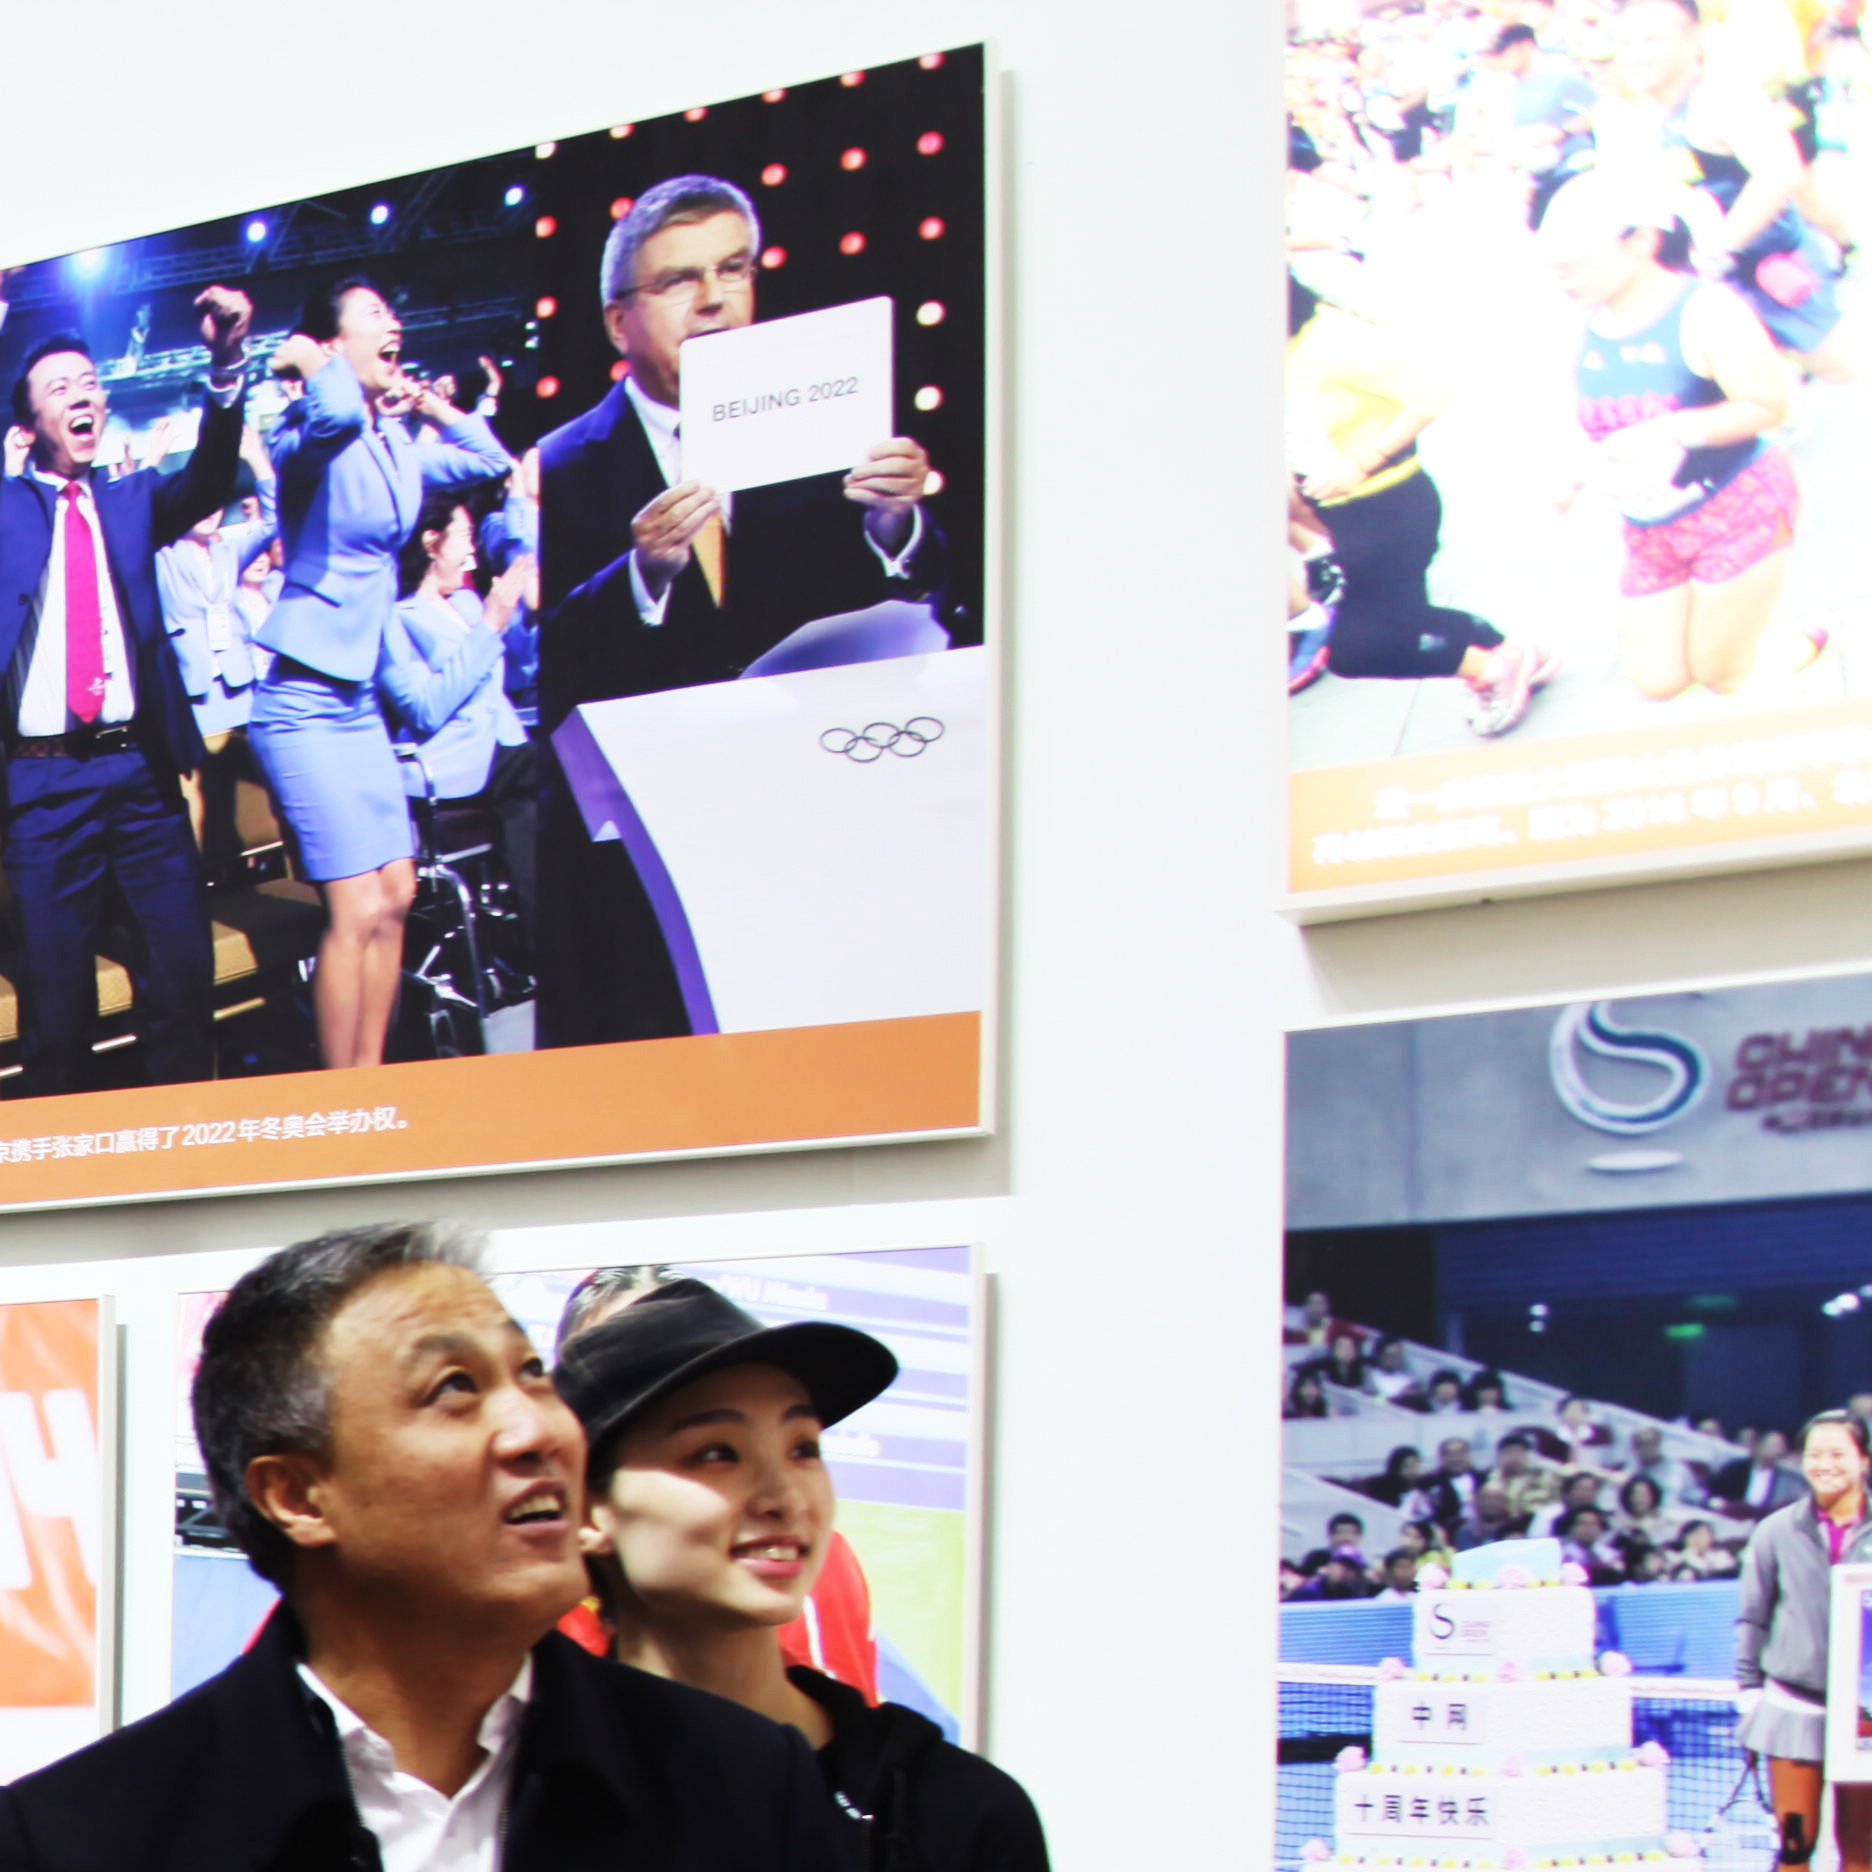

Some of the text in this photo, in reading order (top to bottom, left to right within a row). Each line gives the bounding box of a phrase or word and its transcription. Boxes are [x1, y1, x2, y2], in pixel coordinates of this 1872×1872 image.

[712, 376, 859, 423] BEIJING 2022
[1354, 1794, 1489, 1826] 十周年快乐
